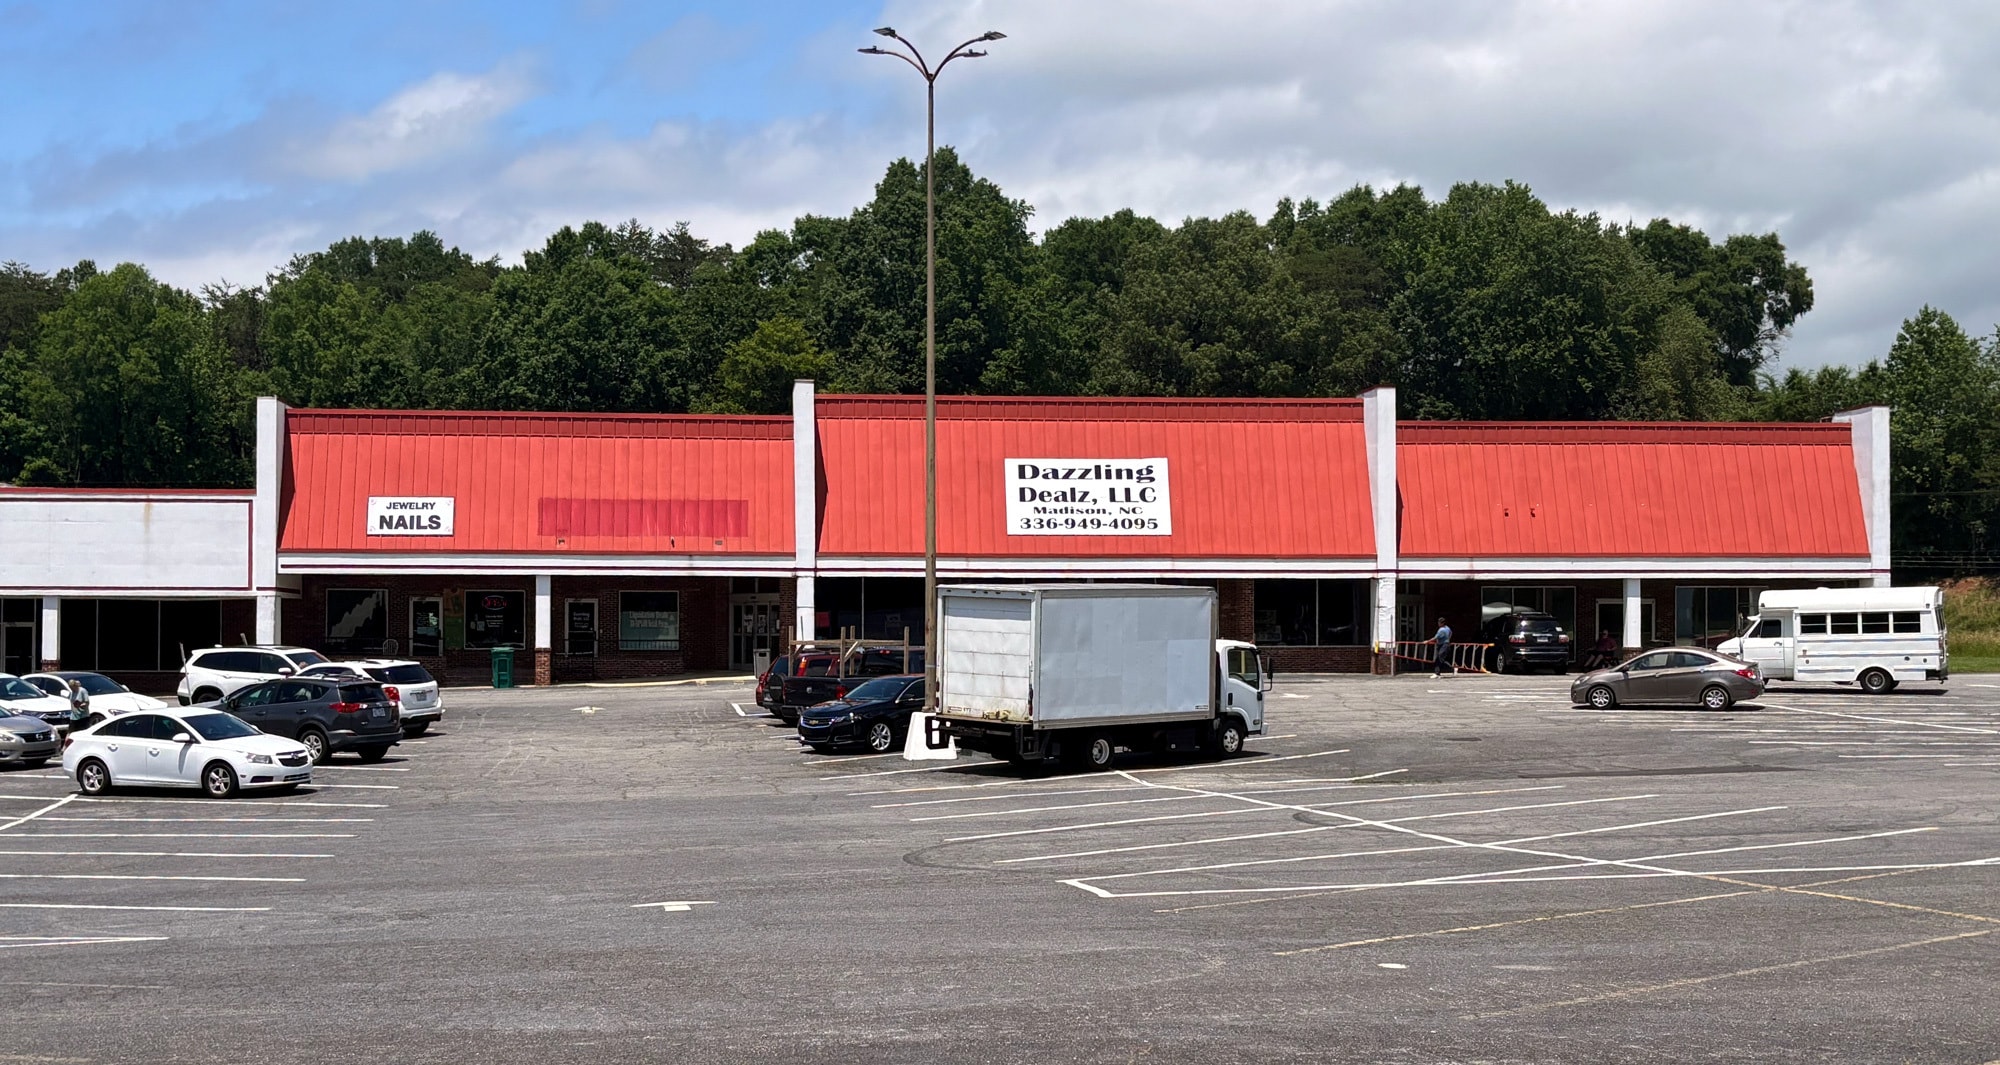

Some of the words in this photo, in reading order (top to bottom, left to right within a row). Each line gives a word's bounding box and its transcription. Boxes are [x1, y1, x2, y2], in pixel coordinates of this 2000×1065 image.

[1017, 464, 1156, 484] Dazzling
[1018, 487, 1098, 505] Dealz,
[1108, 487, 1157, 503] LLC
[386, 502, 436, 511] JEWELRY
[1033, 506, 1112, 516] Madison,
[1118, 506, 1143, 515] NC
[379, 514, 442, 531] NAILS
[1020, 517, 1159, 530] 336-949-4095
